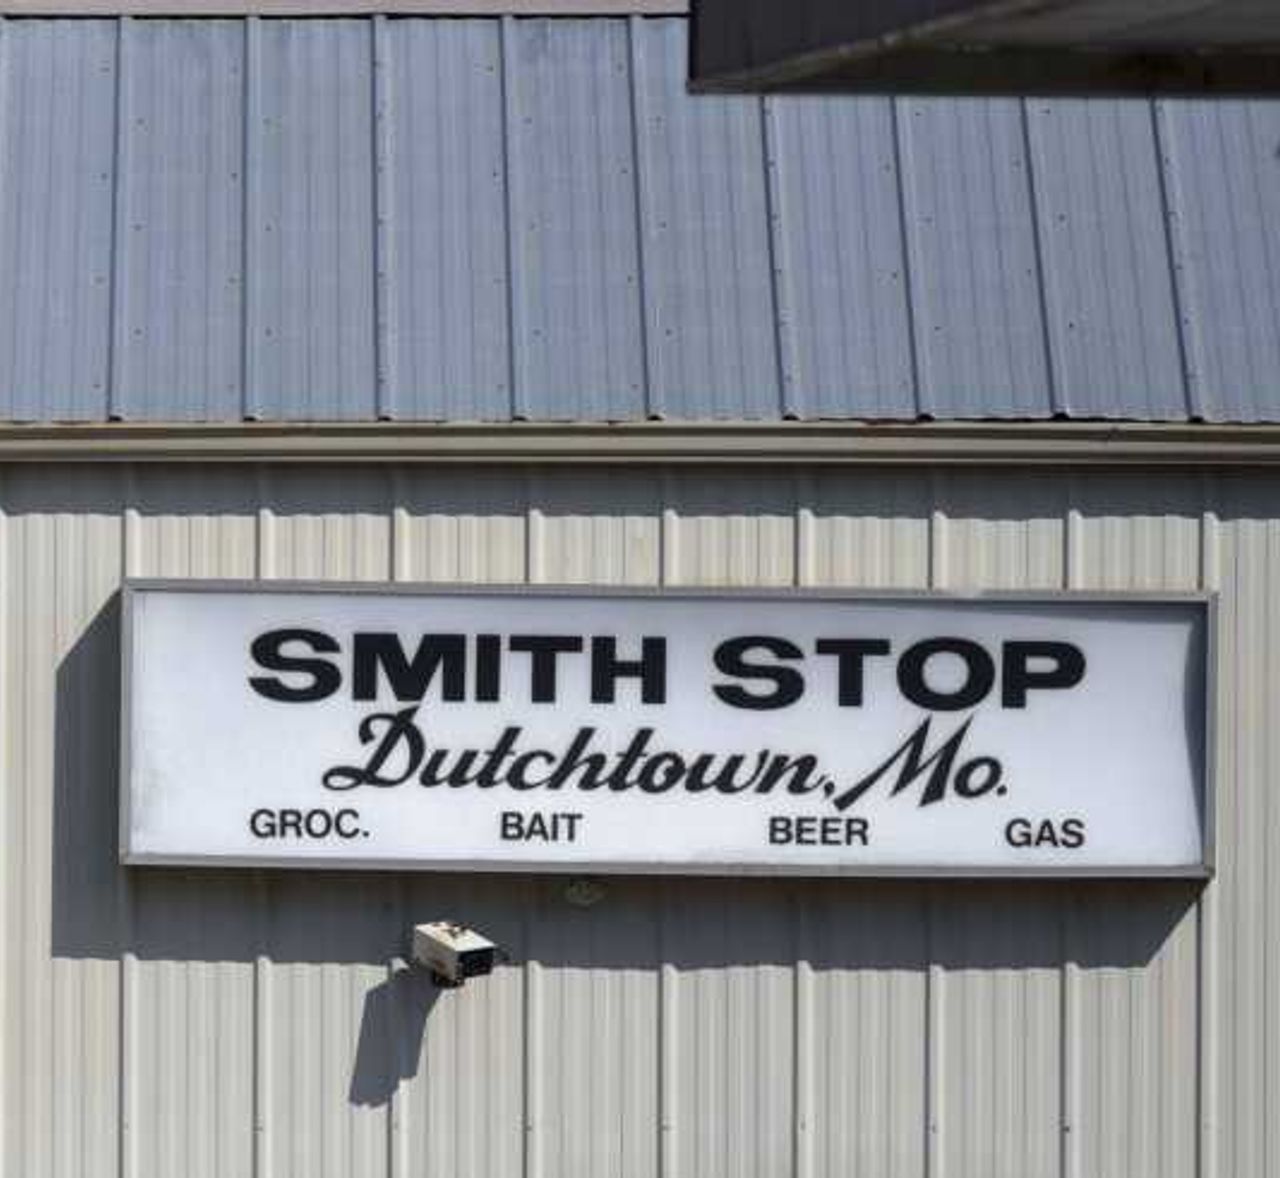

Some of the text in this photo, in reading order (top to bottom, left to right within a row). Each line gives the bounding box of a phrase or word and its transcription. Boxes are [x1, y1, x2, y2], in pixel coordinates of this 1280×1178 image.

[248, 628, 1087, 711] SMITH STOP
[322, 705, 1008, 812] Dutchtown, Mo.
[250, 809, 1086, 848] GROC. BAIT BEER GAS
